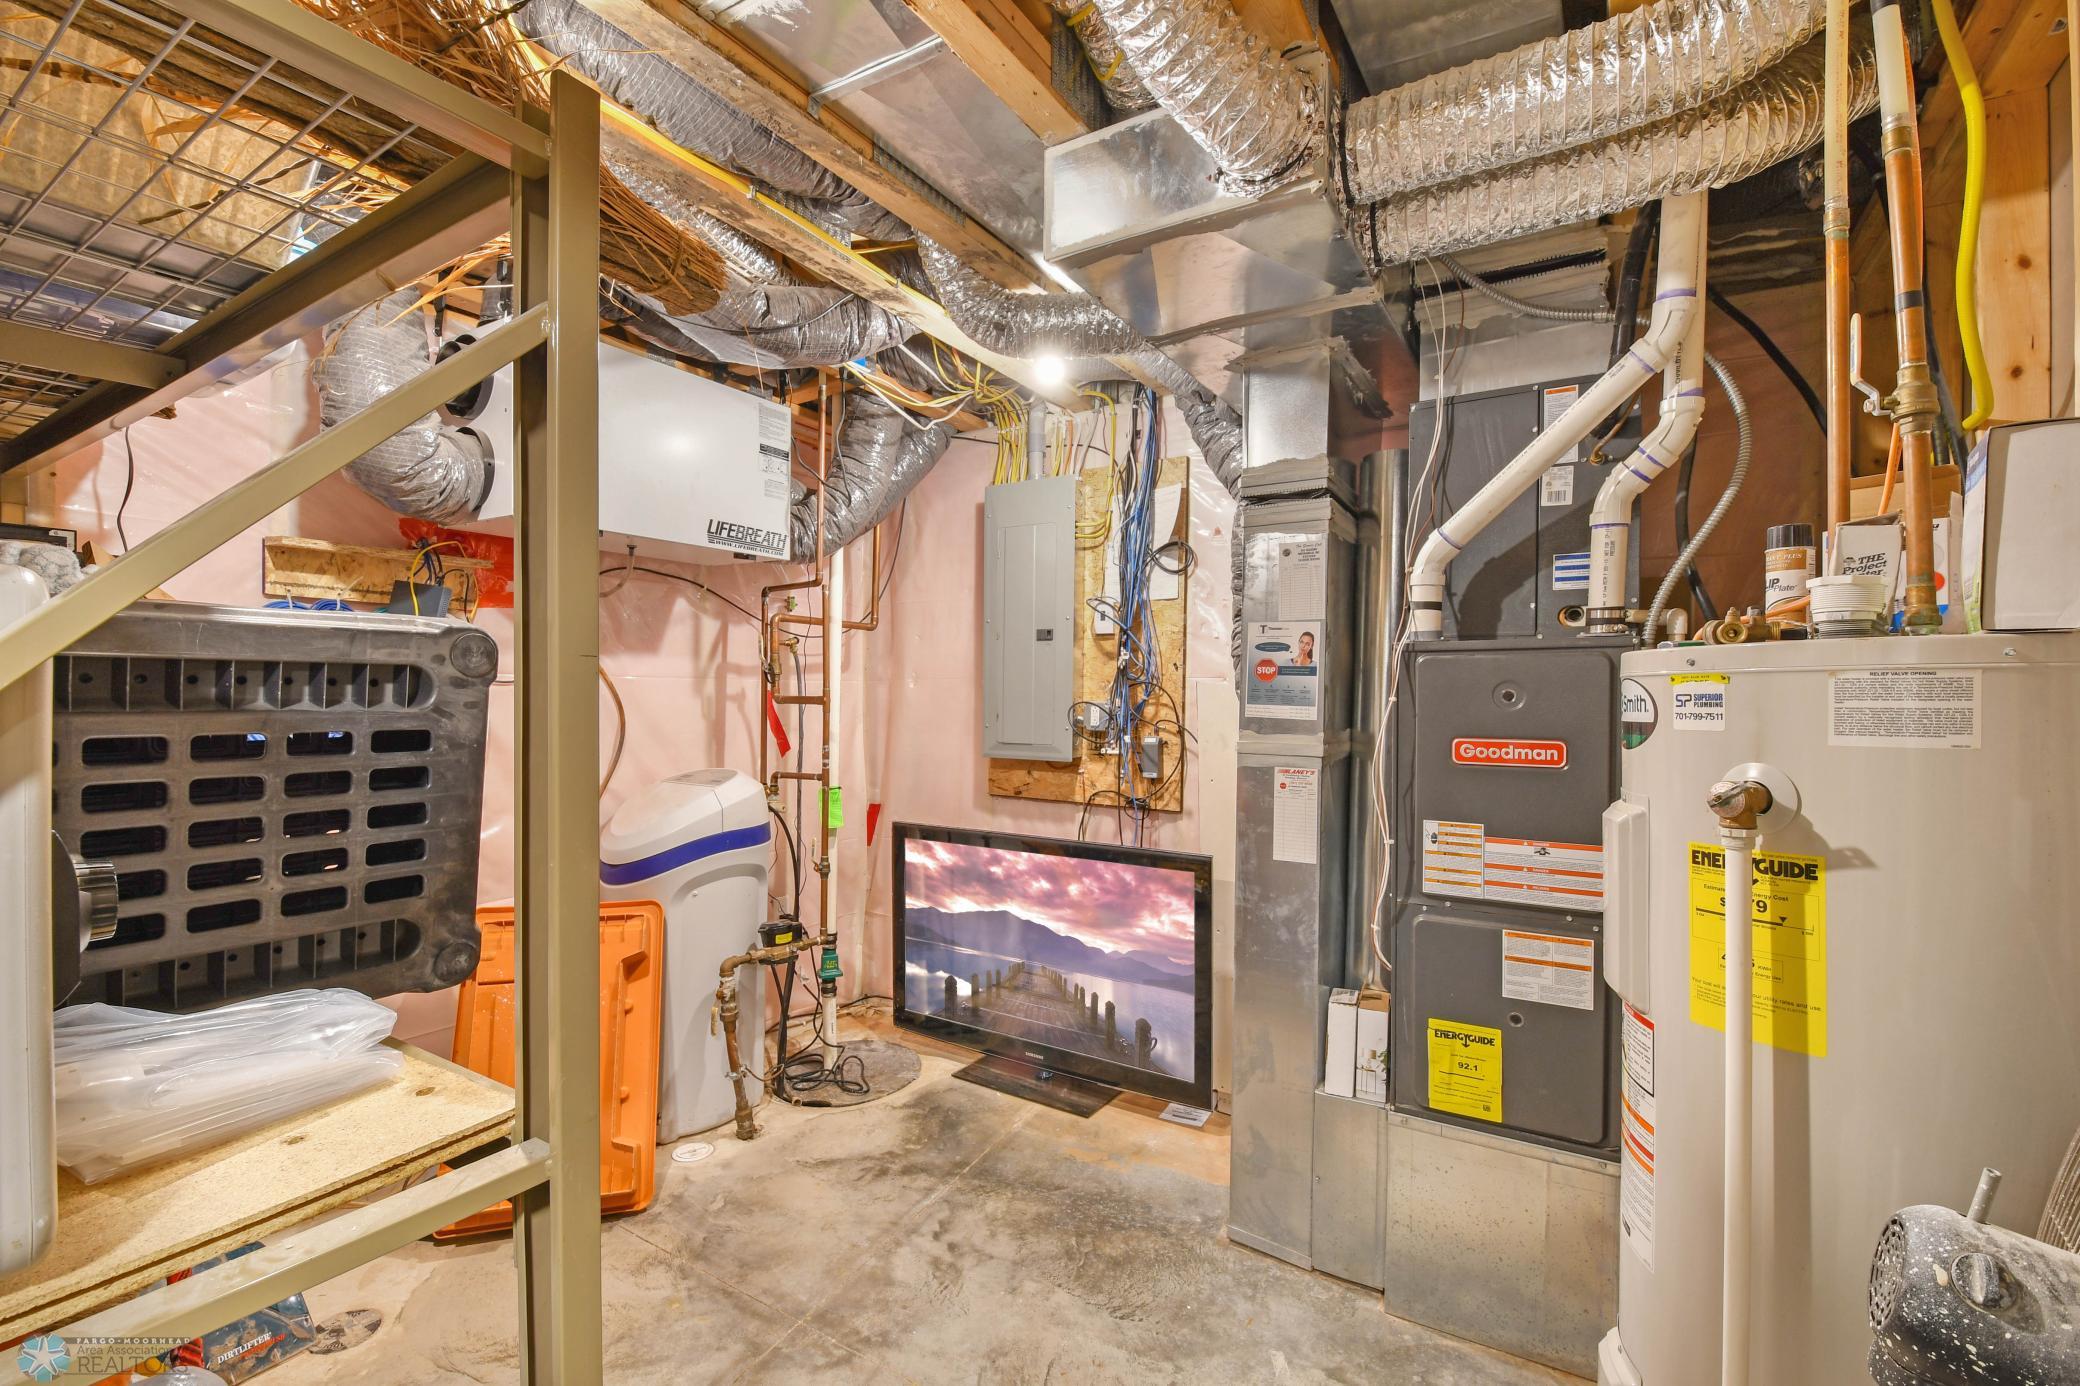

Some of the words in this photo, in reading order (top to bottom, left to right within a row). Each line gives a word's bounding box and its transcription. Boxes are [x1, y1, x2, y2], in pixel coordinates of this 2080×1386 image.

[707, 519, 787, 549] LIFEBREATH
[1858, 552, 1885, 564] THE
[1842, 560, 1887, 575] Project
[1256, 666, 1276, 675] STOP
[1694, 693, 1723, 702] SUPERIOR
[1674, 712, 1723, 721] 701-799-7511
[1459, 743, 1558, 761] Goodman
[1434, 1028, 1496, 1047] ENERGYGUIDE
[1458, 1061, 1478, 1072] 92.1
